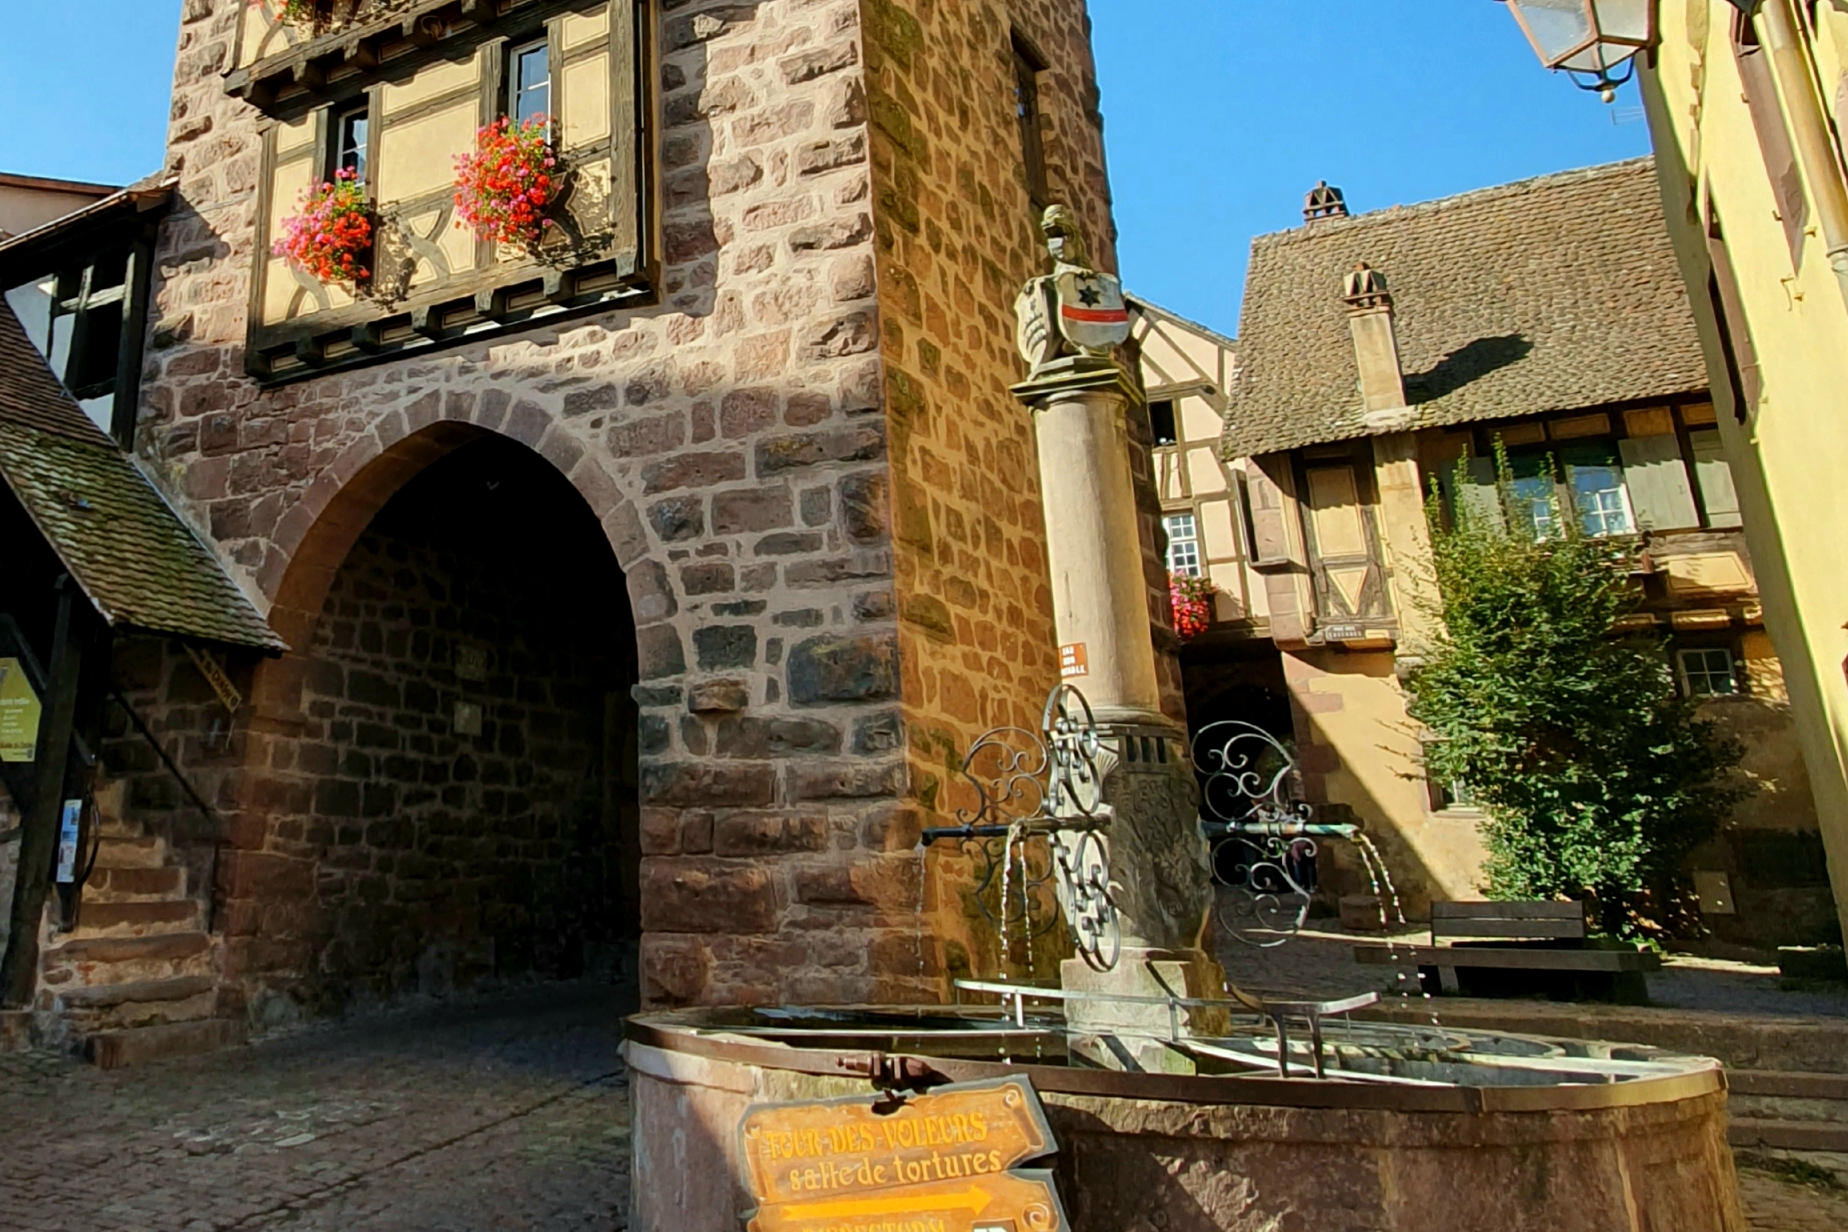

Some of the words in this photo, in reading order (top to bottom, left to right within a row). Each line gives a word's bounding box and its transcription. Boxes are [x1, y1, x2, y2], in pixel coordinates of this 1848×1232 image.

[766, 1128, 824, 1159] TOUR
[828, 1122, 875, 1155] DES
[882, 1112, 988, 1149] VOLEURS
[789, 1161, 854, 1192] salle
[857, 1156, 888, 1186] de
[893, 1149, 1002, 1183] tortures
